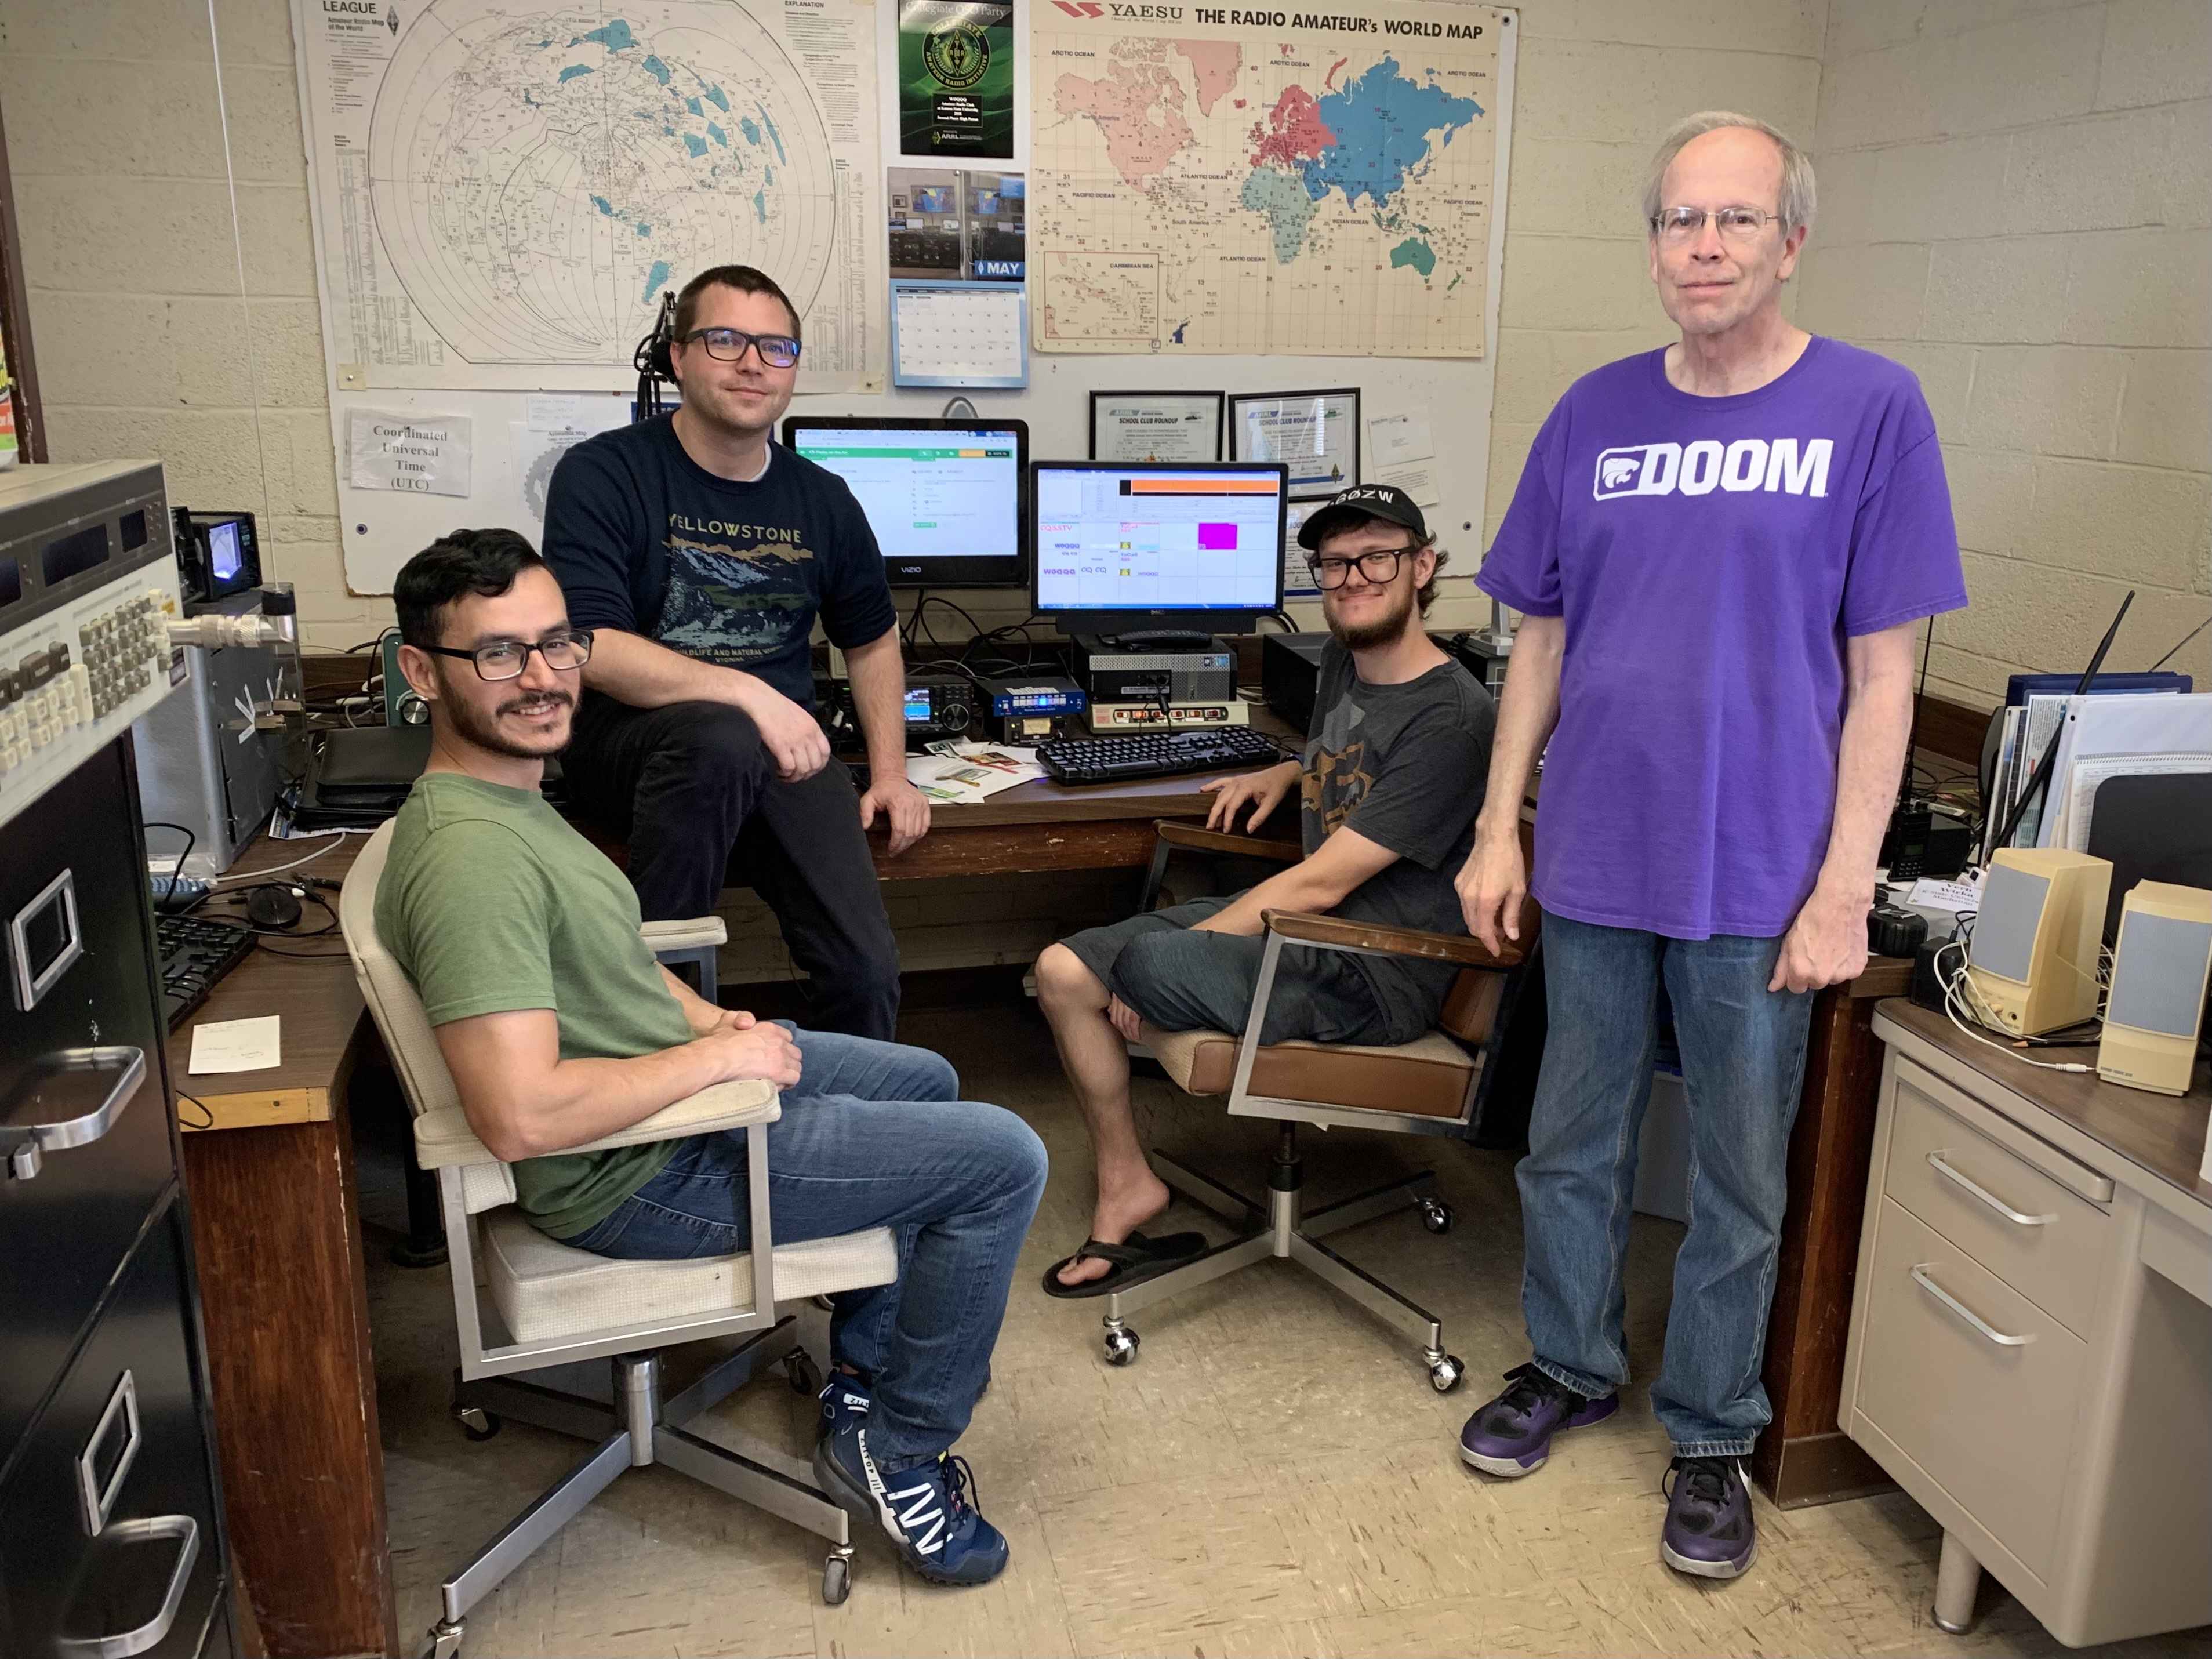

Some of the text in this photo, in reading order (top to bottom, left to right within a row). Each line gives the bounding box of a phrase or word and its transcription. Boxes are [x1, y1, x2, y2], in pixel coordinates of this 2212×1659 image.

[323, 0, 377, 14] LEAGUE
[906, 2, 954, 14] Collegiate
[980, 7, 1005, 19] Party
[1109, 3, 1483, 40] YAESU THE RADIO AMATEUR's WORLD MAP
[987, 262, 1020, 275] MAY
[1259, 418, 1278, 426] SCHOOL
[373, 424, 448, 441] Coordinated
[382, 442, 439, 458] Universal
[395, 459, 426, 473] Time
[1637, 438, 1834, 498] DOOM
[391, 477, 430, 492] (UTC)
[668, 513, 802, 543] YELLOWSTONE
